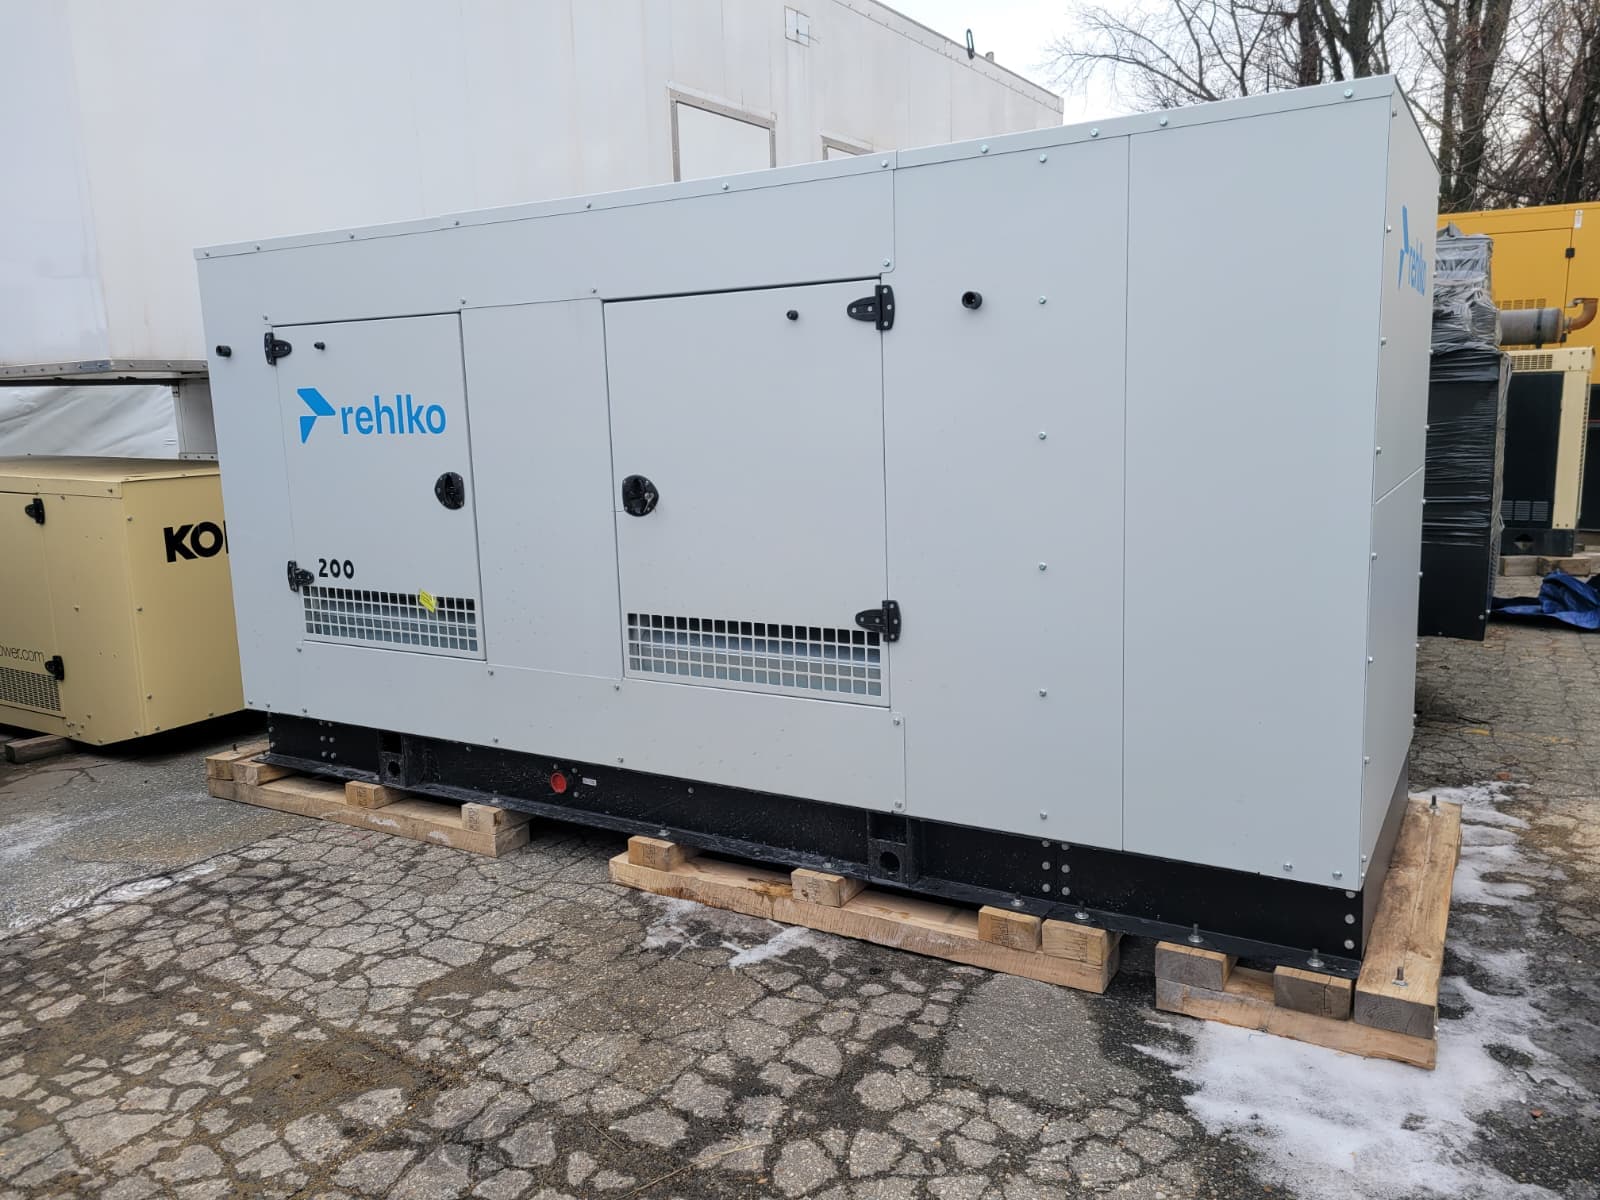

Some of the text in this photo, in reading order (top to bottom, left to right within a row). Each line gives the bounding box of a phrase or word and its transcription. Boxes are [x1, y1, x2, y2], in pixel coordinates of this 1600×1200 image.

[341, 394, 446, 434] rehlko
[163, 520, 228, 562] KO
[318, 558, 354, 579] 200
